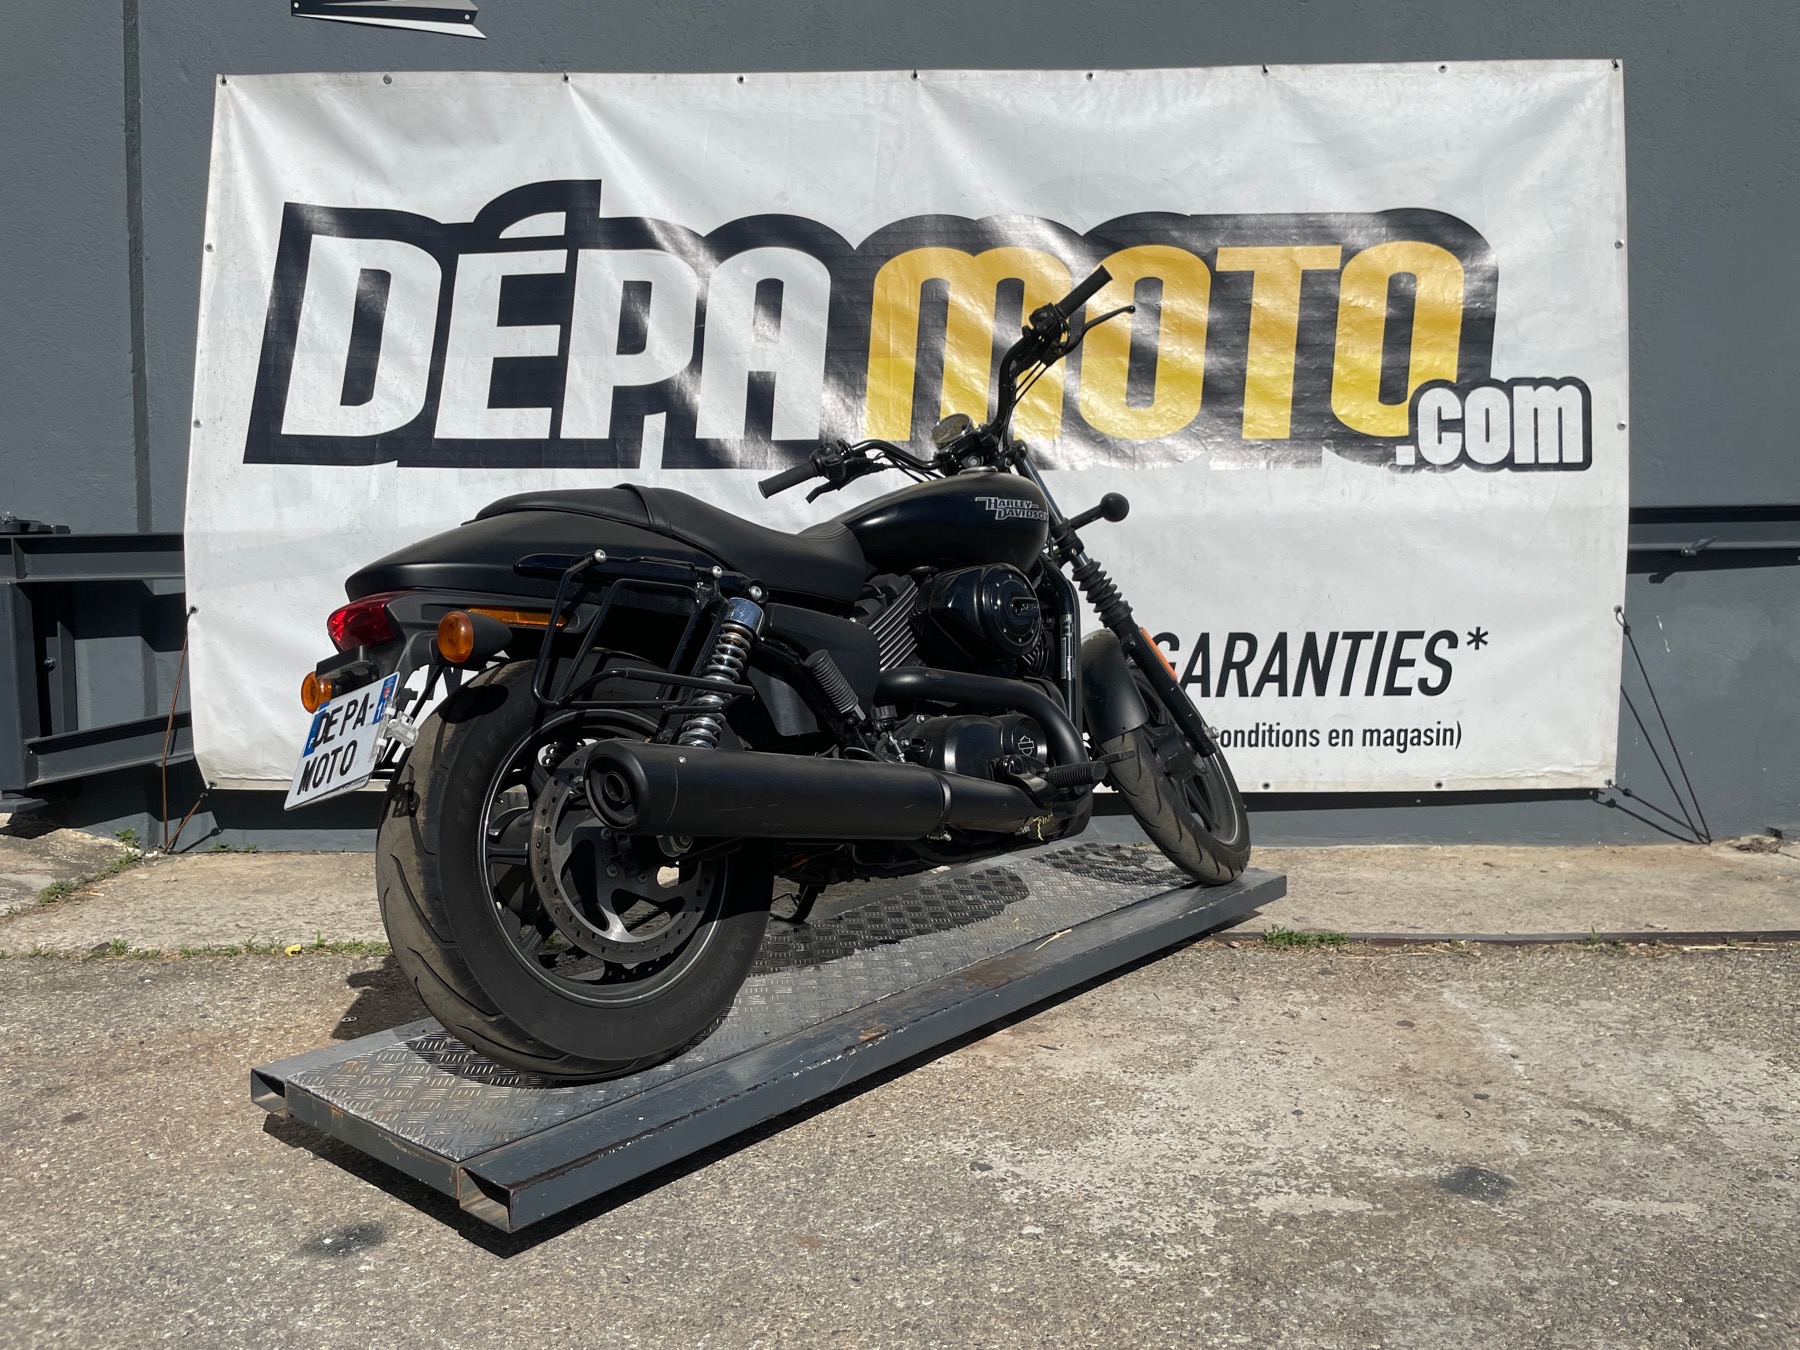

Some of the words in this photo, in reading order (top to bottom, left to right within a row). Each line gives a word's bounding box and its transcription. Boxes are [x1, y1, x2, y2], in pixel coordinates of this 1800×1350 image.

[1219, 722, 1320, 748] onditions
[1328, 726, 1354, 748] en
[1361, 719, 1463, 754] magasin)
[296, 739, 358, 796] MOTO
